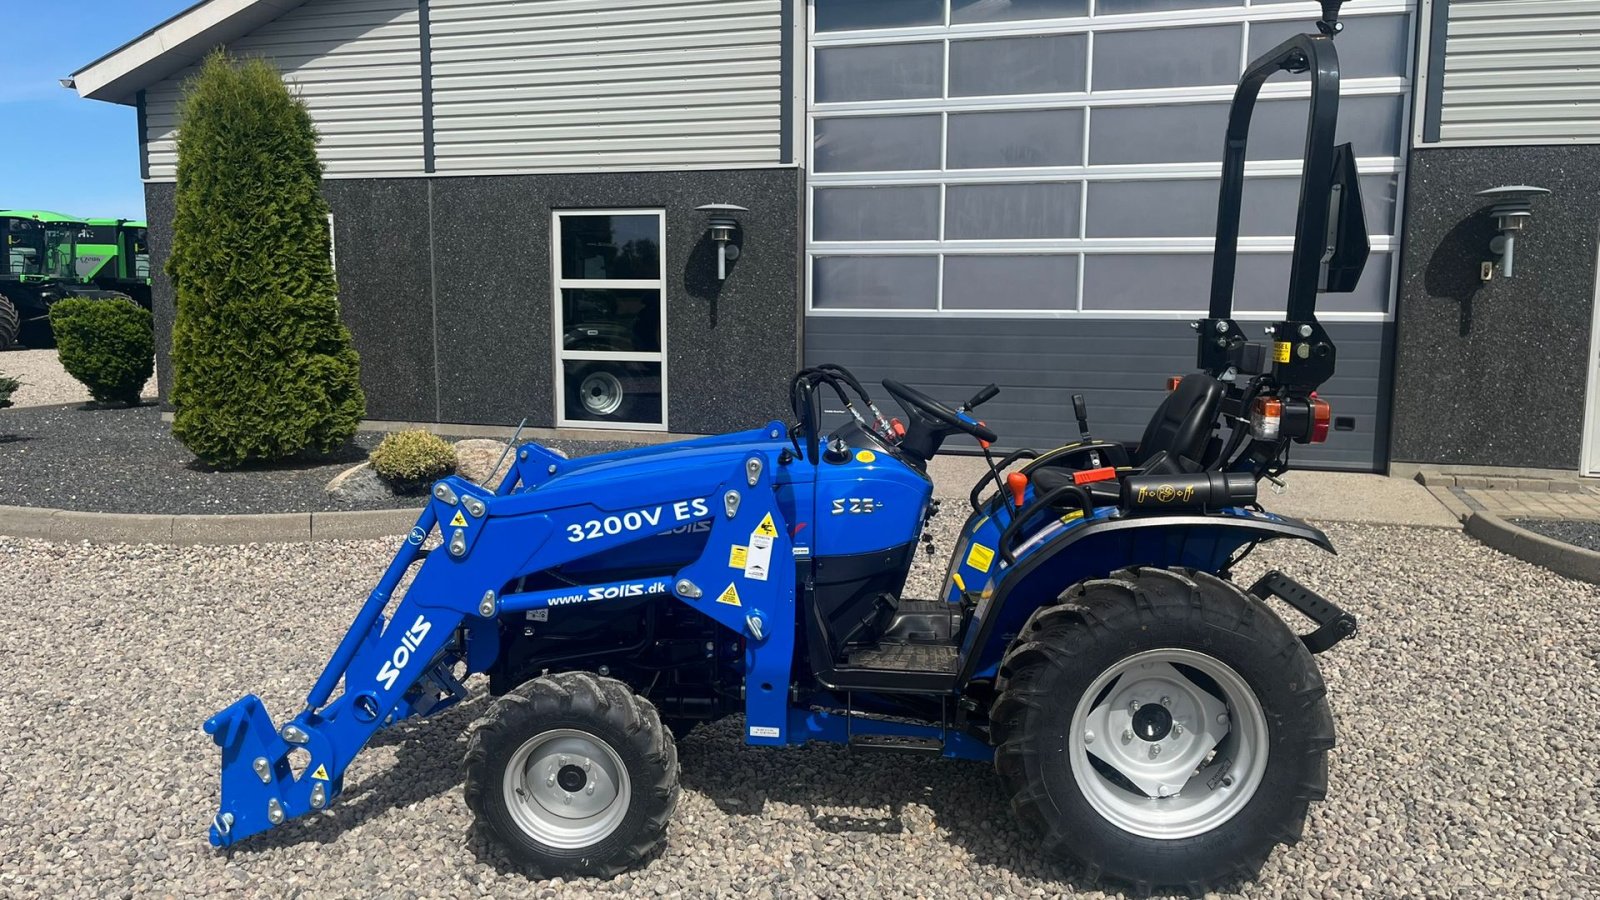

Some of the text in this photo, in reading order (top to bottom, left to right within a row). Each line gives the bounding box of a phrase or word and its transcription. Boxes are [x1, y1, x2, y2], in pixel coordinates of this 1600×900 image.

[566, 498, 709, 542] 3200V ES
[831, 498, 846, 514] S
